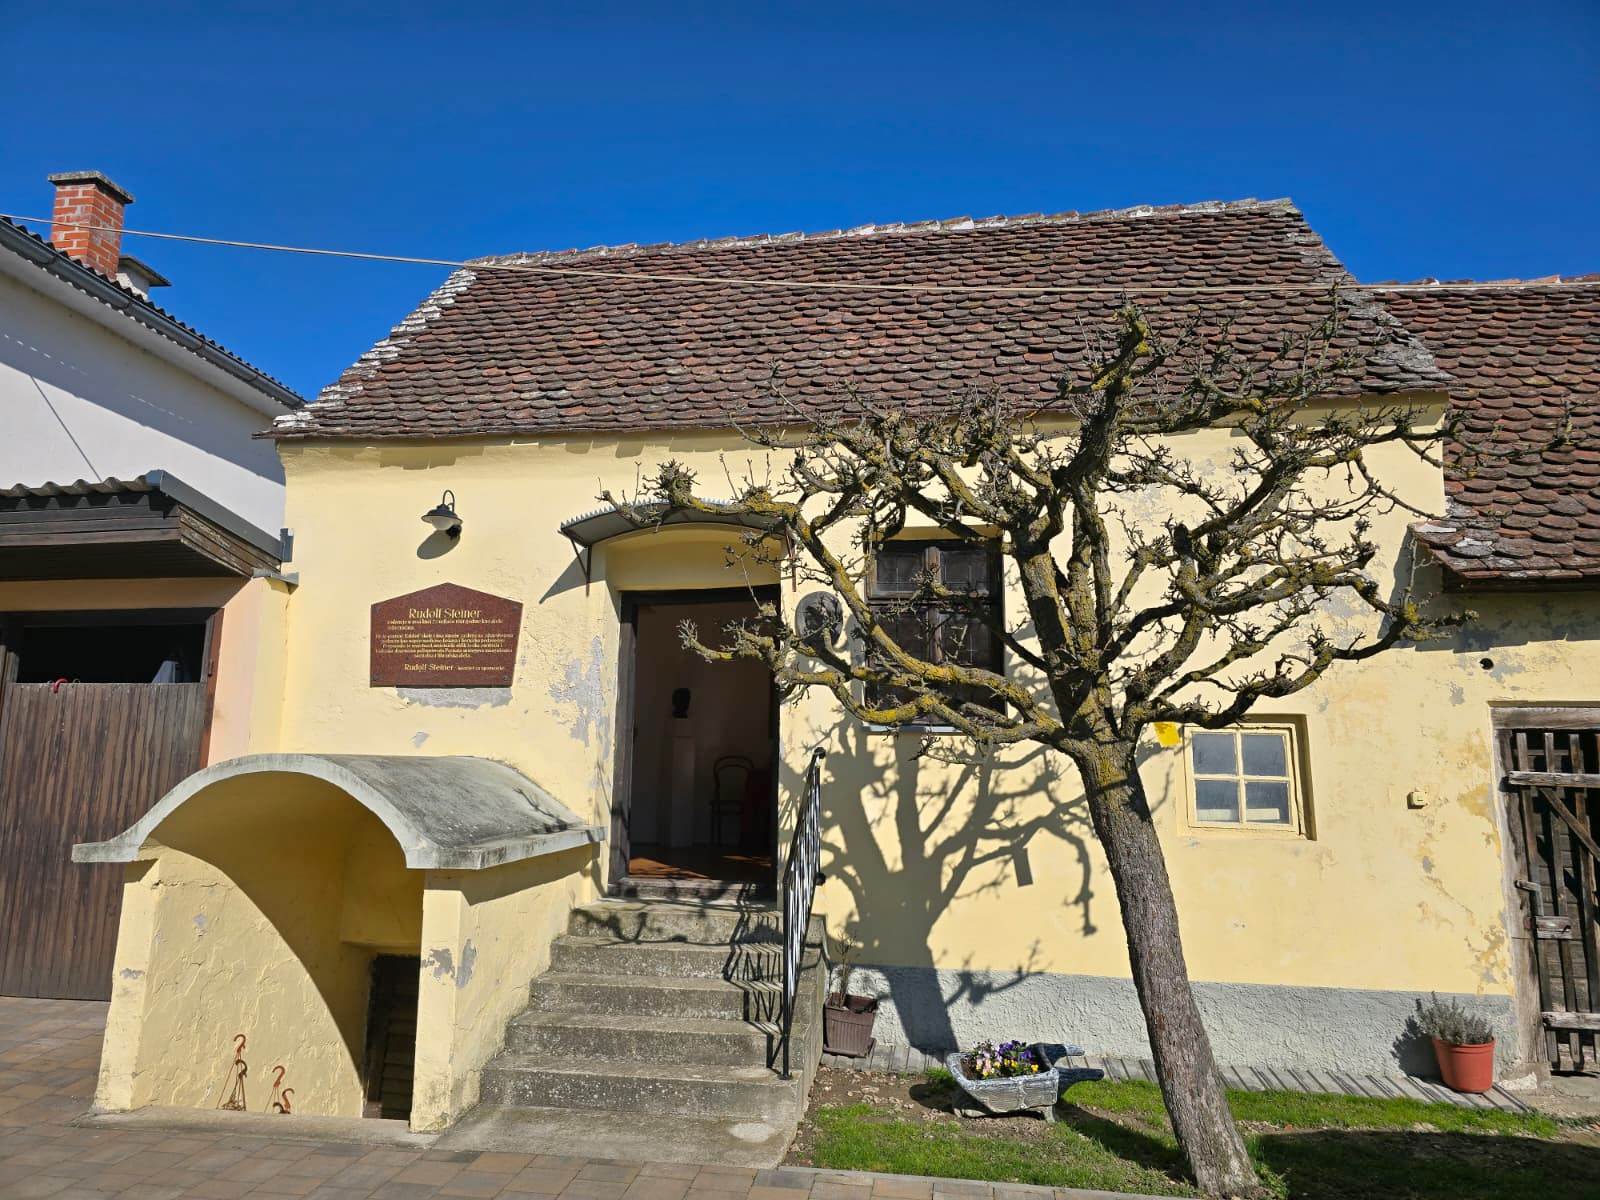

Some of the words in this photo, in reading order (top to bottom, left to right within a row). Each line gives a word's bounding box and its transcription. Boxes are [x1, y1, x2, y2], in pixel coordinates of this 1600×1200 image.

[408, 607, 441, 619] Rudolf
[444, 607, 482, 619] Steiner
[404, 663, 427, 672] Rudolf
[428, 663, 453, 671] Steiner
